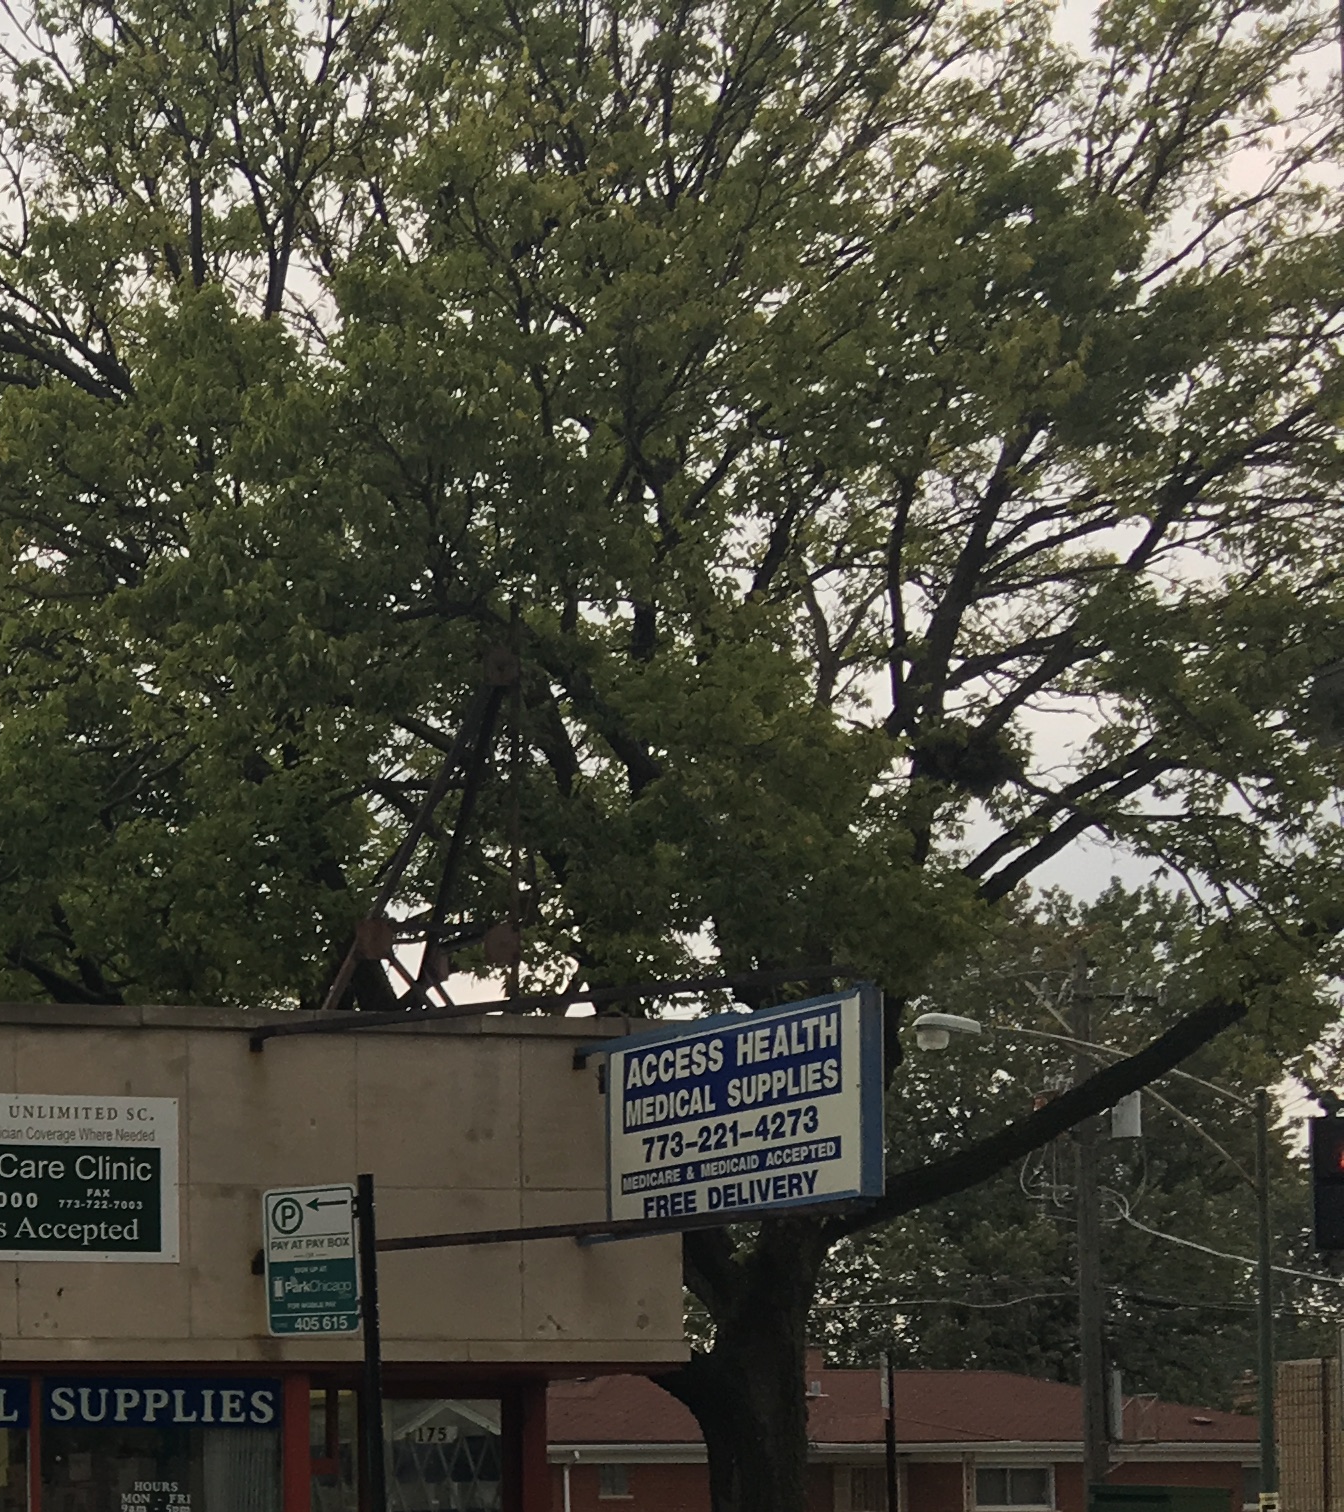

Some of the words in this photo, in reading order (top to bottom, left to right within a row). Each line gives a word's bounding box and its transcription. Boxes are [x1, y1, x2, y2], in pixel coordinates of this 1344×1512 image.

[626, 1038, 724, 1090] ACCESS
[736, 1012, 838, 1067] HEALTH
[625, 1085, 716, 1128] MEDICAL
[727, 1058, 839, 1108] SUPPLIES
[9, 1105, 118, 1121] UNLIMITED
[126, 1108, 155, 1121] SC.
[26, 1127, 75, 1143] Coverage
[78, 1128, 113, 1142] Where
[115, 1129, 155, 1143] Needed
[642, 1105, 820, 1163] 773-221-4273
[75, 1154, 152, 1182] Clinic
[623, 1168, 681, 1191] MEDICARE
[686, 1166, 695, 1181] &
[700, 1154, 760, 1178] MEDICAID
[765, 1141, 836, 1167] ACCEPTED
[86, 1188, 111, 1198] FAX
[643, 1189, 697, 1219] FREE
[707, 1169, 819, 1210] DELIVERY
[58, 1199, 143, 1210] 773-722-7003
[281, 1205, 295, 1228] P
[14, 1217, 139, 1245] Accepted
[271, 1241, 289, 1251] PAY
[291, 1240, 304, 1249] AT
[306, 1239, 325, 1249] PAY
[327, 1237, 350, 1248] BOX
[294, 1317, 319, 1331] 405
[322, 1315, 348, 1330] 615
[49, 1387, 275, 1424] SUPPLIES
[134, 1481, 179, 1492] HOURS
[121, 1493, 151, 1504] MON
[169, 1494, 191, 1504] FRI
[121, 1504, 147, 1512] 9am
